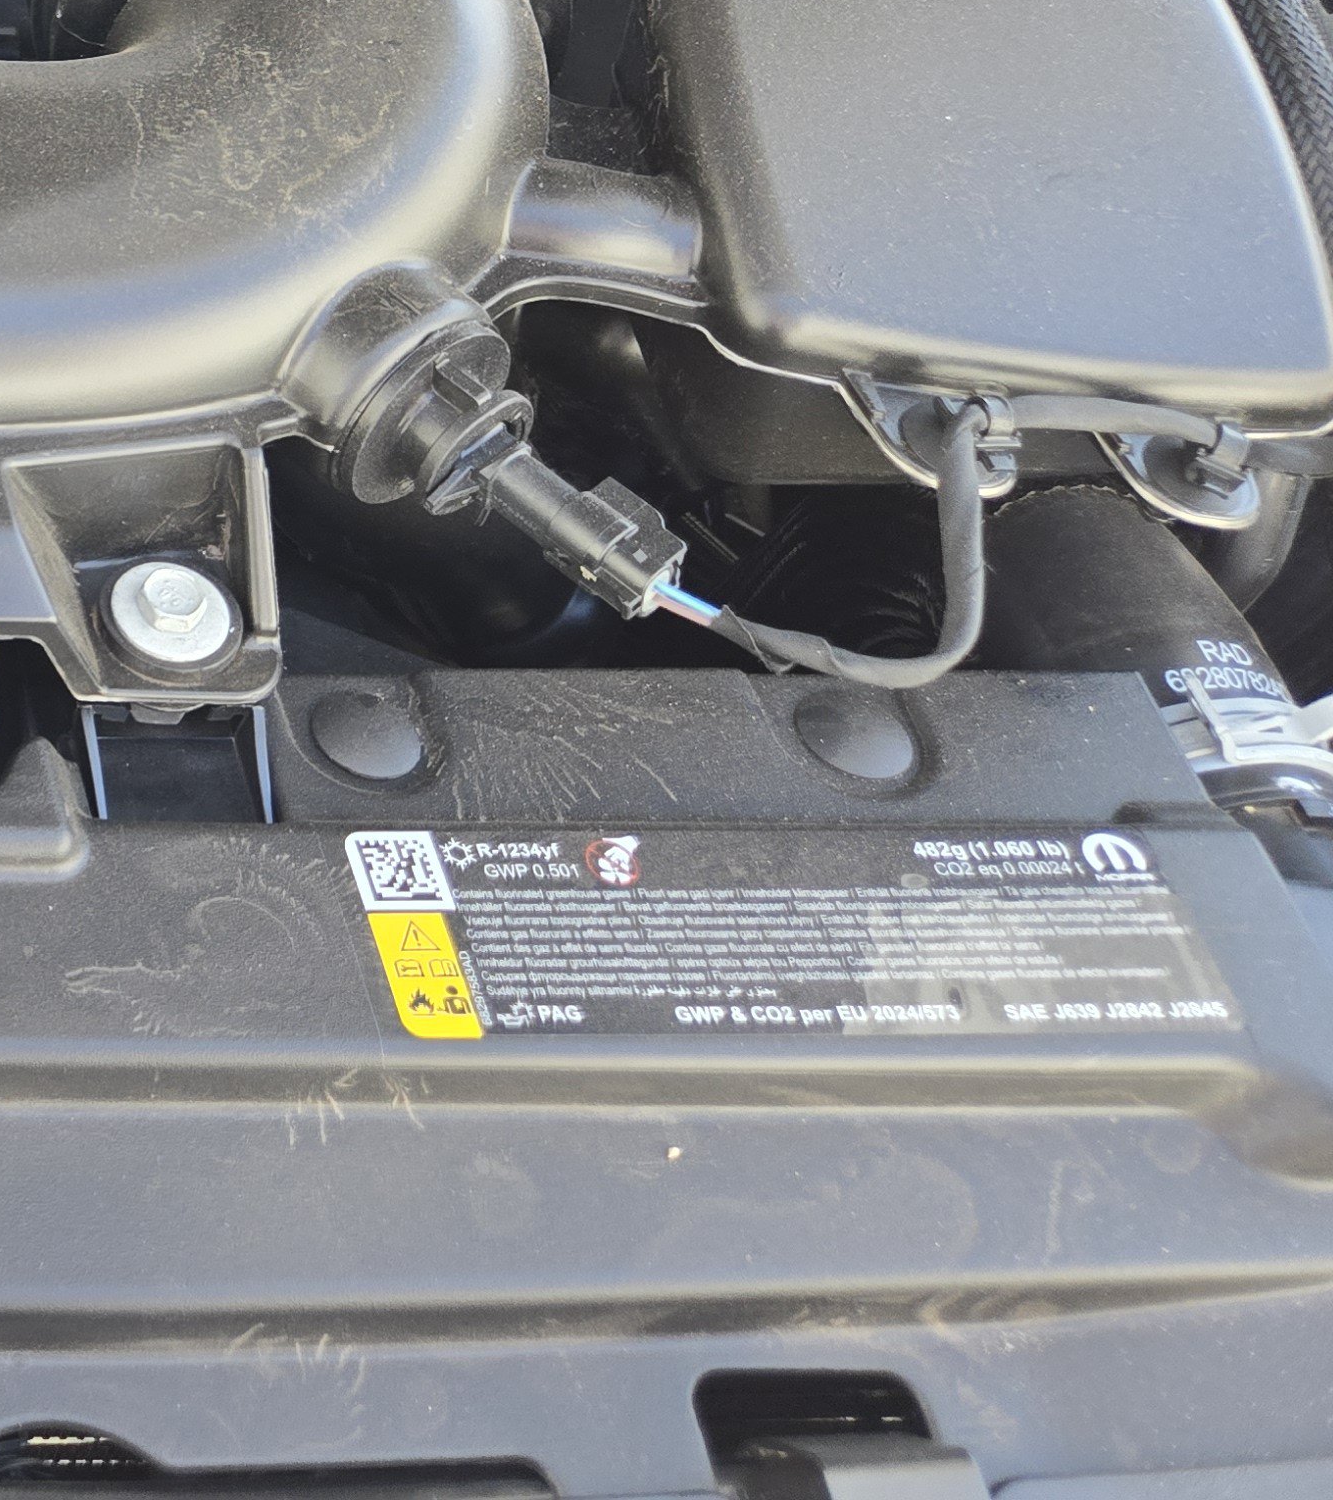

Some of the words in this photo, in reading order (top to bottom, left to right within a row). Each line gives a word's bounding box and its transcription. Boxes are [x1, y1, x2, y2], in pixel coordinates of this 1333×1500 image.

[1196, 639, 1253, 666] RAD
[476, 842, 561, 862] R-1234yf
[913, 840, 968, 861] 482g
[968, 840, 1035, 861] (1.060
[1038, 839, 1071, 859] lb)
[483, 863, 527, 879] GWP
[531, 863, 580, 879] 0.501
[933, 861, 974, 877] CO2
[978, 863, 1003, 879] eq
[1003, 861, 1071, 876] 0.00024
[458, 950, 493, 1027] 68297583AD
[537, 1004, 583, 1023] PAG
[675, 1004, 726, 1024] GWP
[730, 1005, 748, 1023] &
[750, 1005, 797, 1024] CO2
[800, 1007, 833, 1028] per
[836, 1004, 868, 1023] EU
[873, 1004, 961, 1023] 2024/573
[1003, 1003, 1050, 1020] SAE
[1054, 1003, 1101, 1020] J639
[1105, 1002, 1166, 1019] J2842
[1168, 1001, 1229, 1019] J2845
